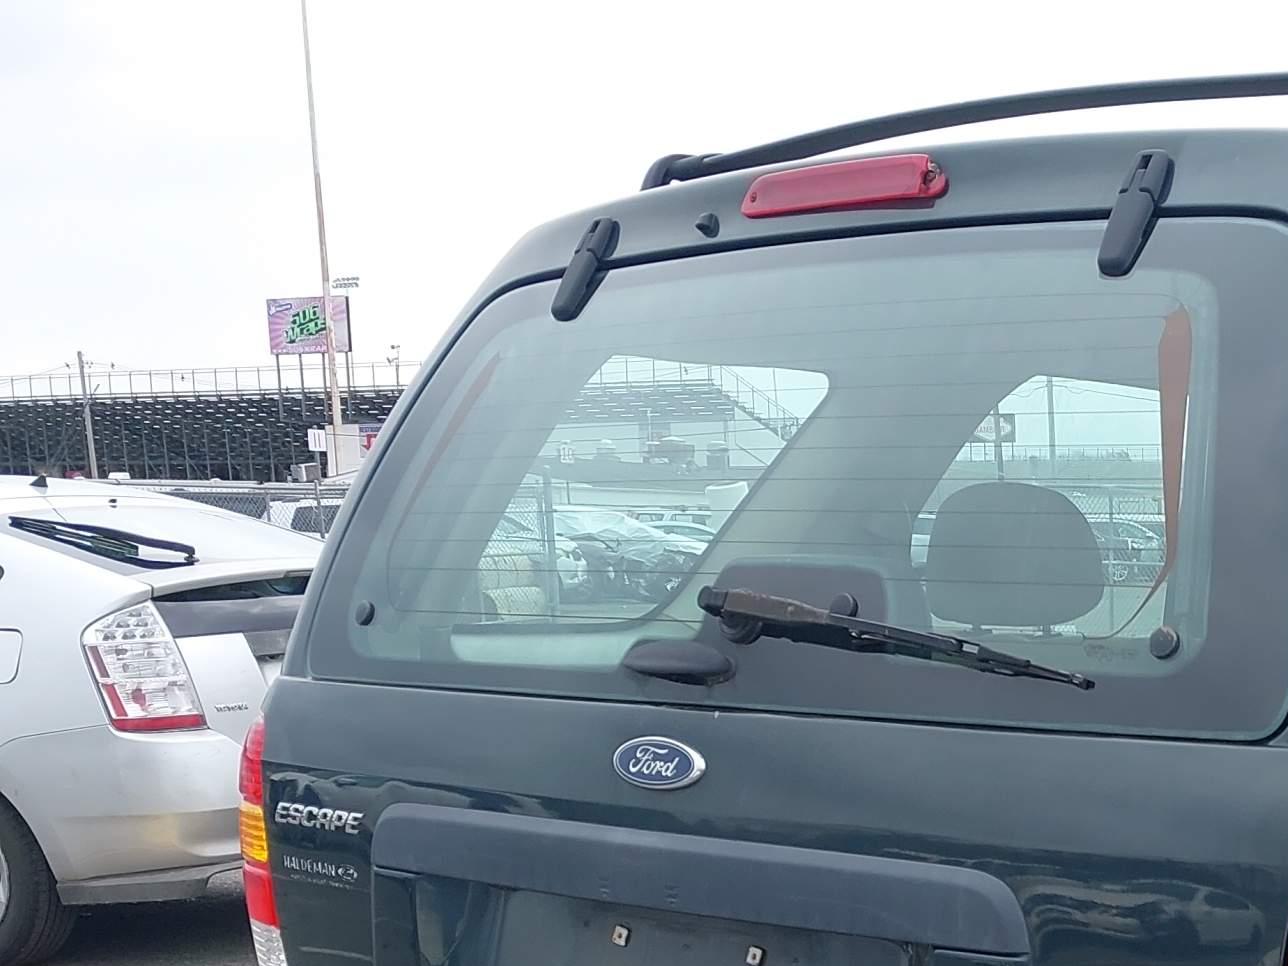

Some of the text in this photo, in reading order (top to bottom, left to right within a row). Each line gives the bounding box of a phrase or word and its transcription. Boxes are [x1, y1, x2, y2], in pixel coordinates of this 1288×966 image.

[628, 744, 680, 777] Ford
[274, 801, 365, 835] ESCAPE
[282, 855, 337, 877] HALDEMAN
